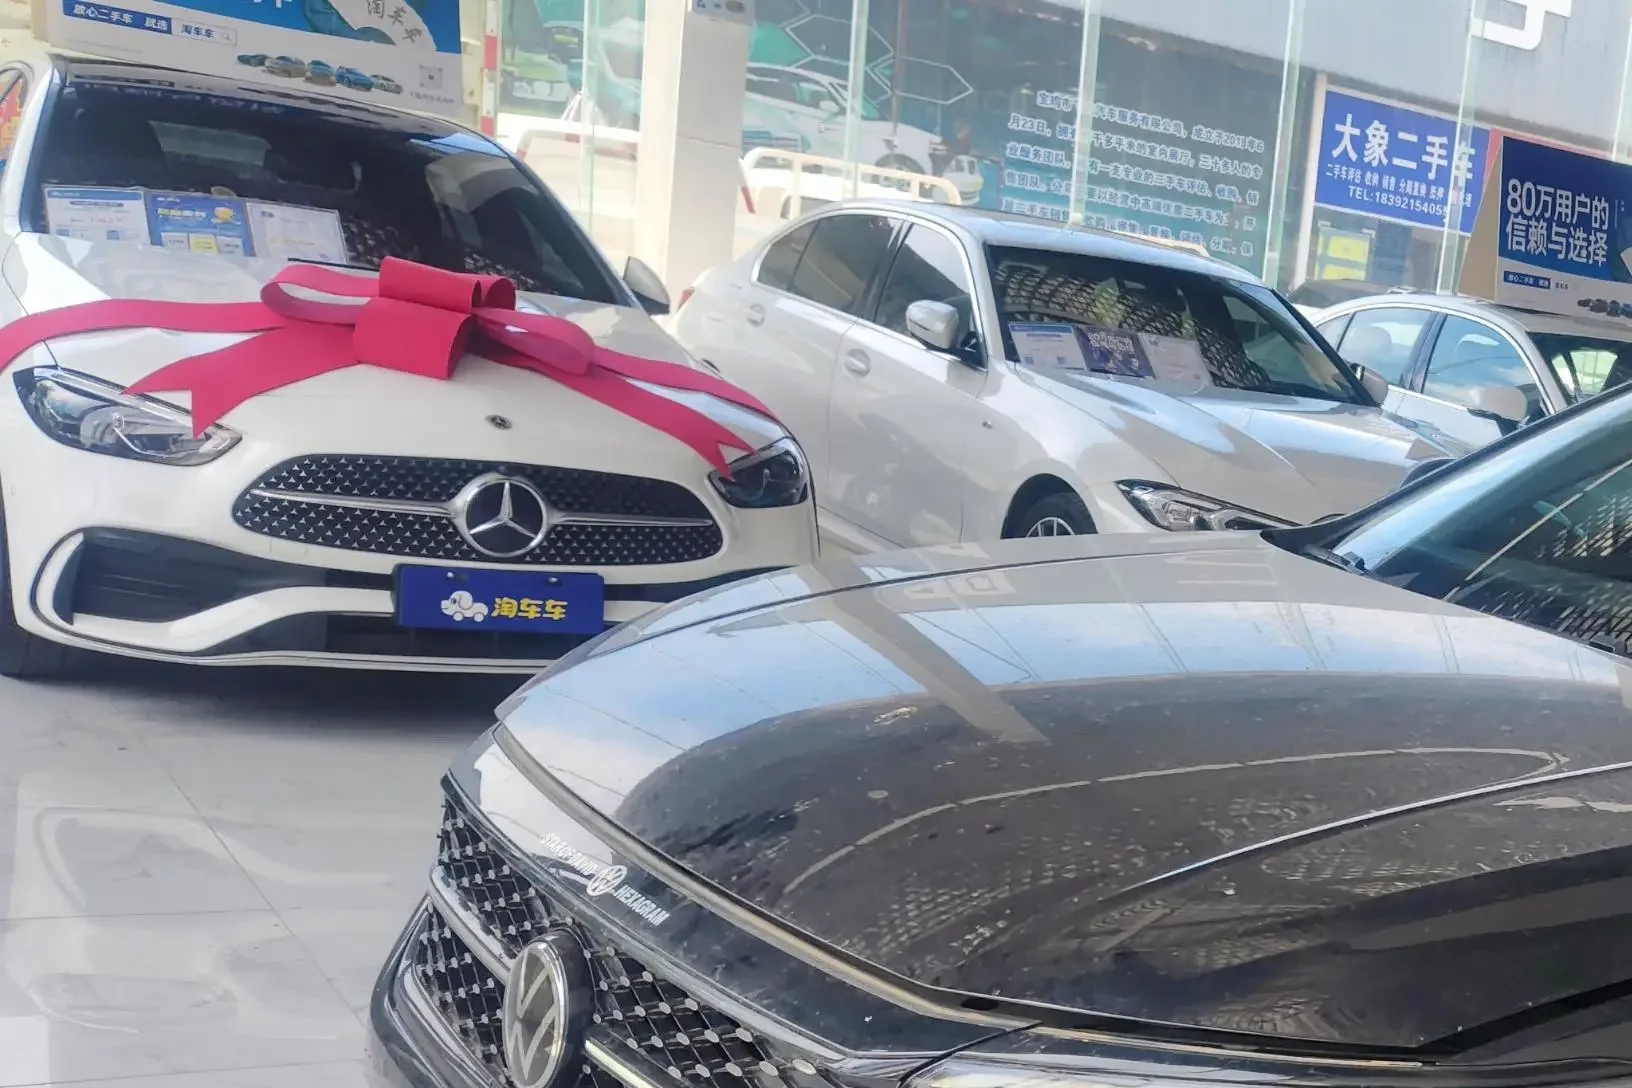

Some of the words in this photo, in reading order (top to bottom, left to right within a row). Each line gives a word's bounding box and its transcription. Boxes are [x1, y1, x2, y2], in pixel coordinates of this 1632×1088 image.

[73, 4, 133, 24] 放心二手车
[181, 23, 215, 39] 淘车车
[1332, 113, 1475, 186] 大象二手车
[1507, 178, 1609, 230] 80万用户的
[1506, 215, 1608, 266] 信赖与选择
[491, 596, 568, 621] 淘车车
[613, 884, 670, 926] HEXAGRAM
